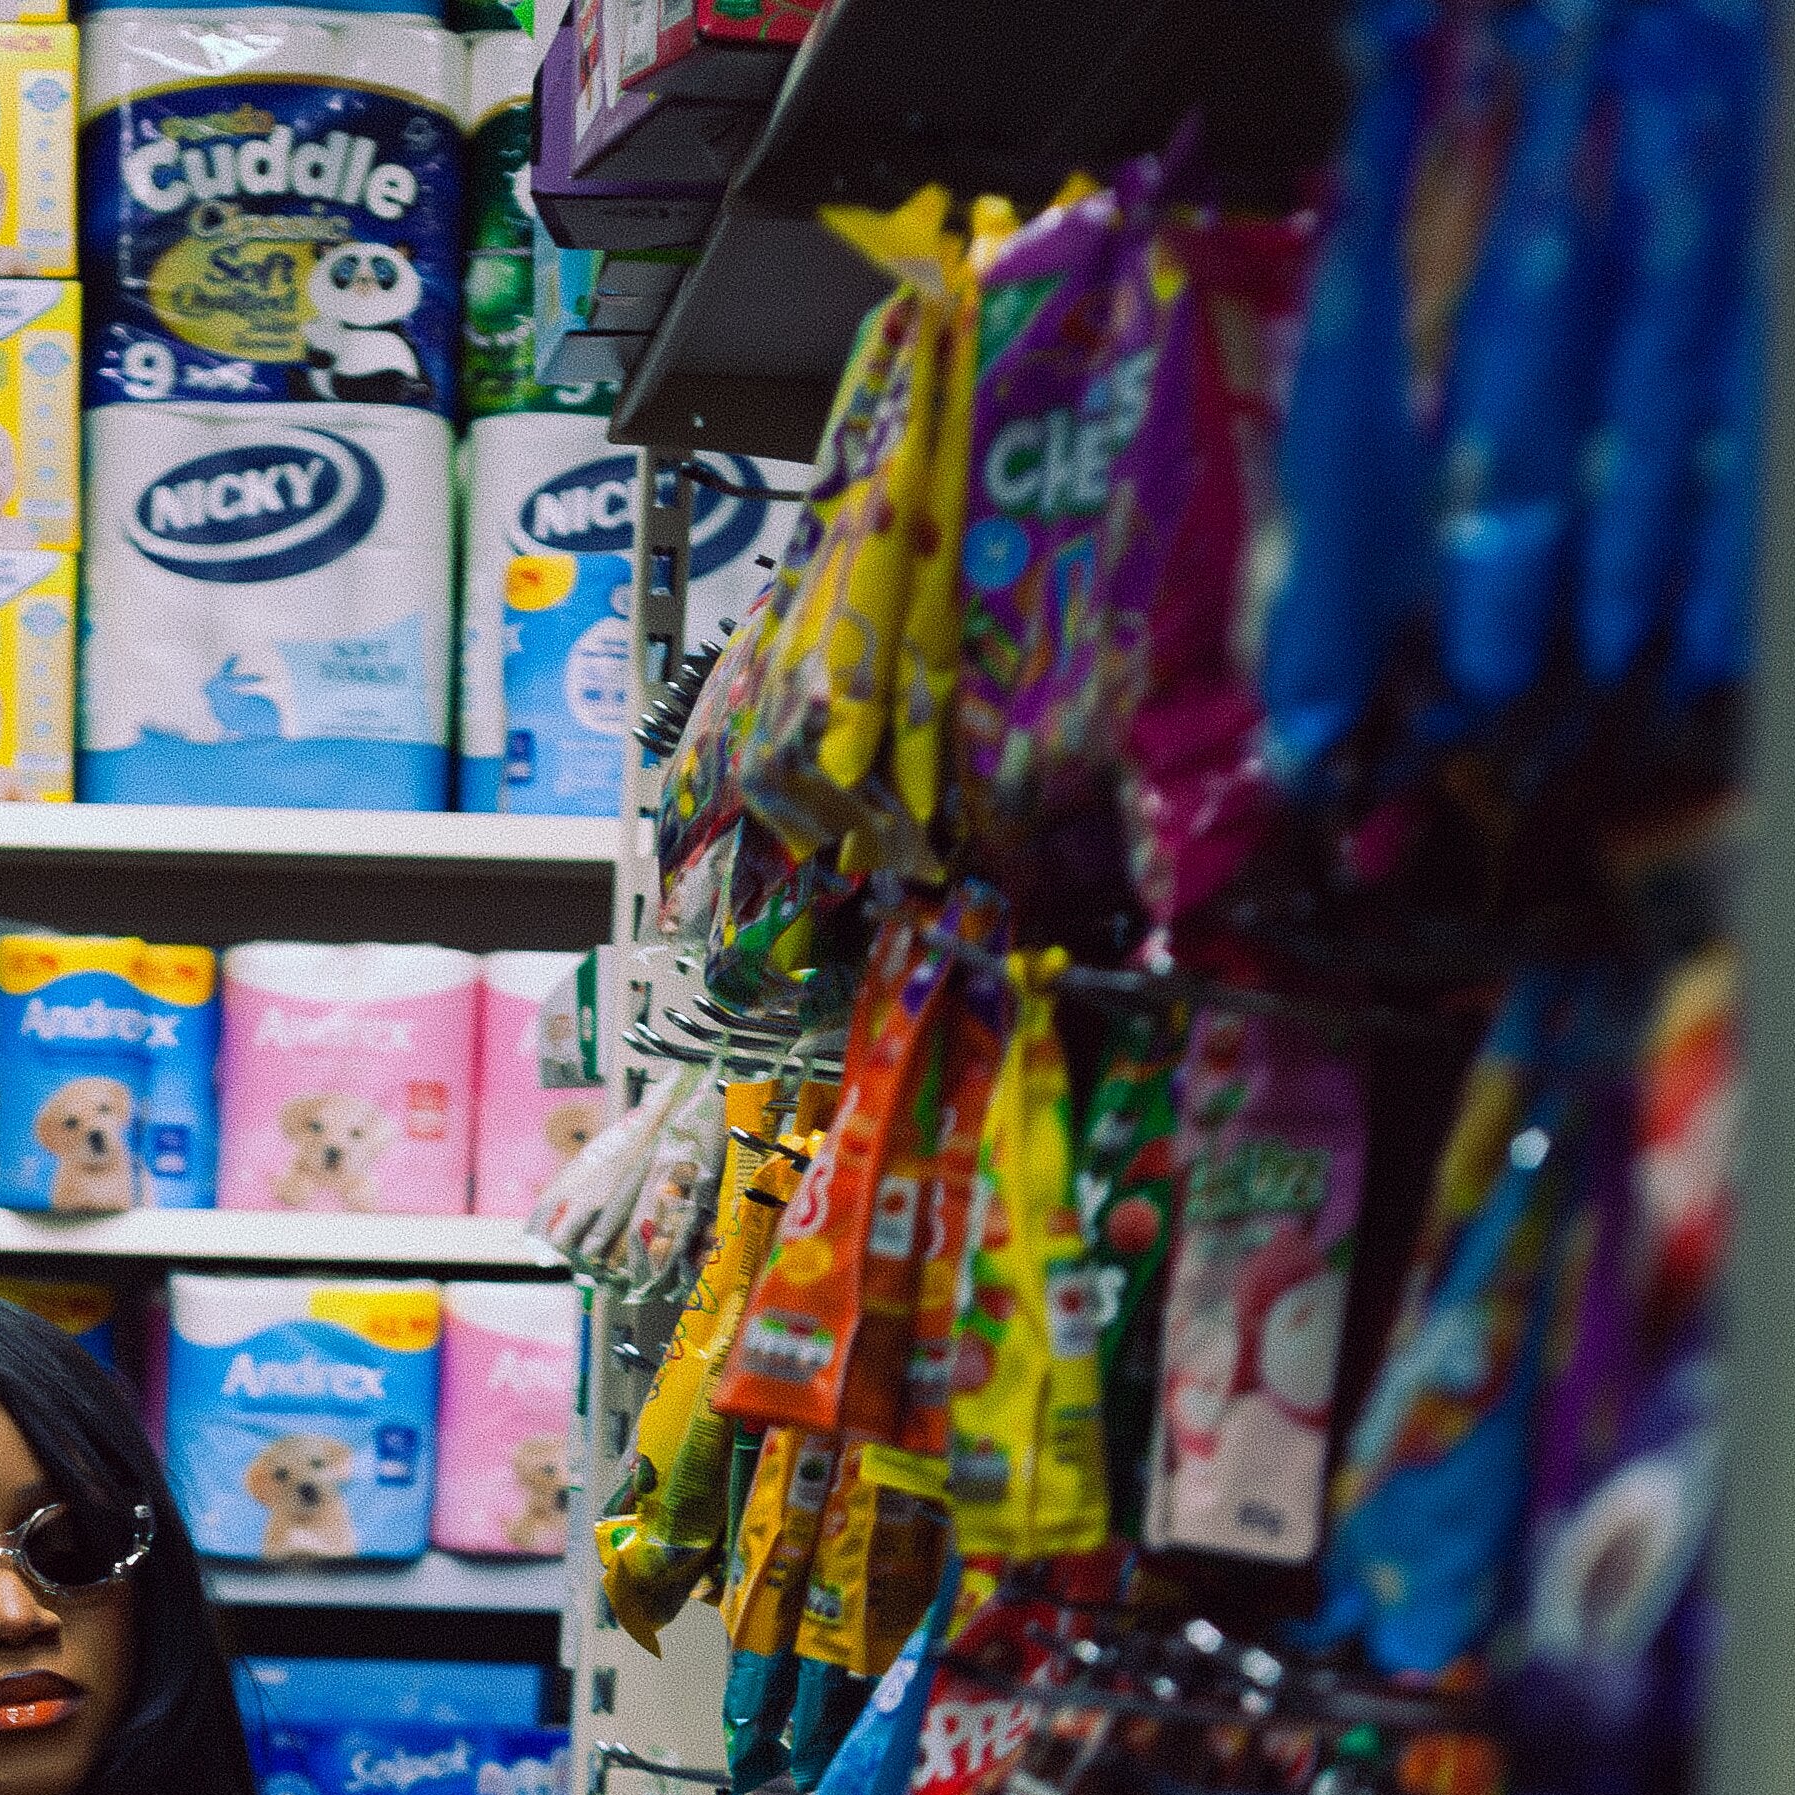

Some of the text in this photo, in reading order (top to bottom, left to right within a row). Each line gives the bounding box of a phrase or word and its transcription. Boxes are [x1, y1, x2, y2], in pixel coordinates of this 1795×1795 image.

[122, 121, 419, 221] Cuddle
[204, 241, 296, 288] Soft
[123, 340, 177, 400] 9
[150, 456, 326, 533] NICKY
[531, 474, 638, 540] NIC
[18, 996, 183, 1050] Andrex
[220, 1351, 388, 1401] Andrex
